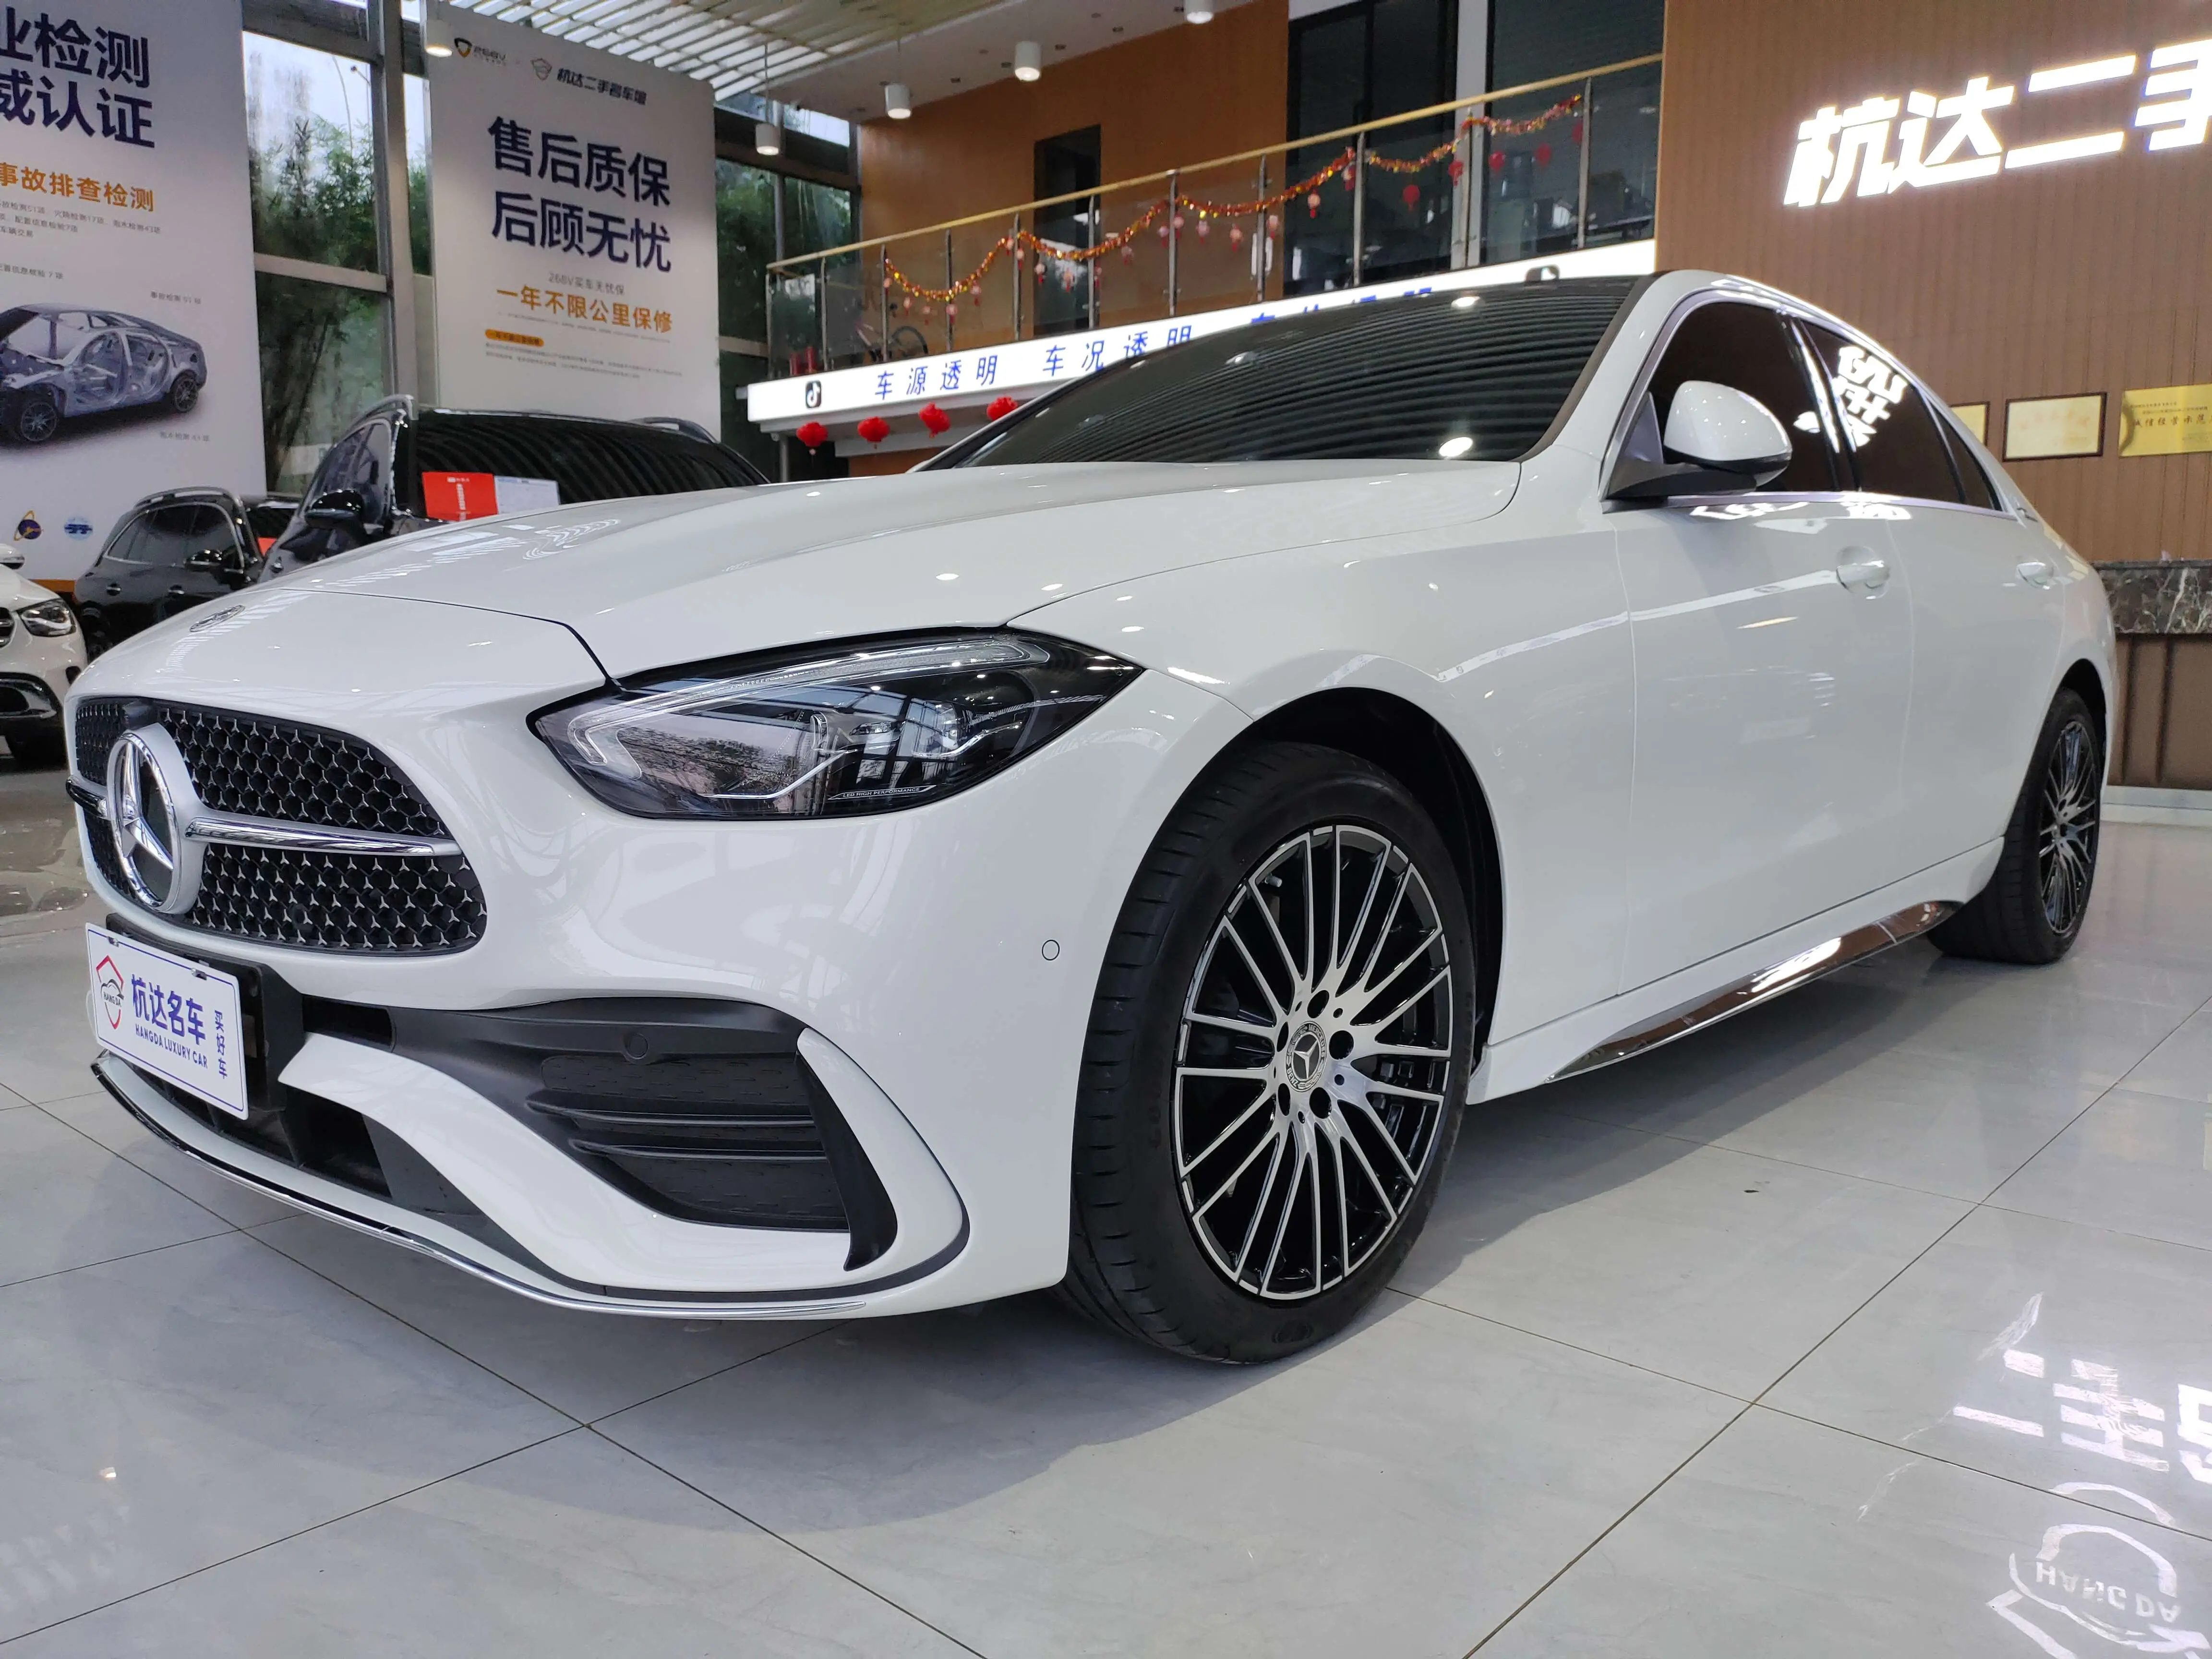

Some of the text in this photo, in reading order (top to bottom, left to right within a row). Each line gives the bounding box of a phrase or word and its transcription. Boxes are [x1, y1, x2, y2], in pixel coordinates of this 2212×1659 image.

[0, 162, 154, 212] 事故排查检测
[488, 116, 671, 206] 售后质保
[492, 191, 671, 273] 后顾无忧
[496, 284, 673, 334] 一年不限公里保修
[875, 325, 1191, 400] 车源透明 车况透明
[873, 787, 920, 795] PERFORMANCE
[131, 974, 206, 1046] 杭达名车
[135, 1023, 208, 1069] HANGDA LUXURY CAR
[215, 1010, 228, 1080] 买好车
[1287, 1067, 1298, 1087] BENZ
